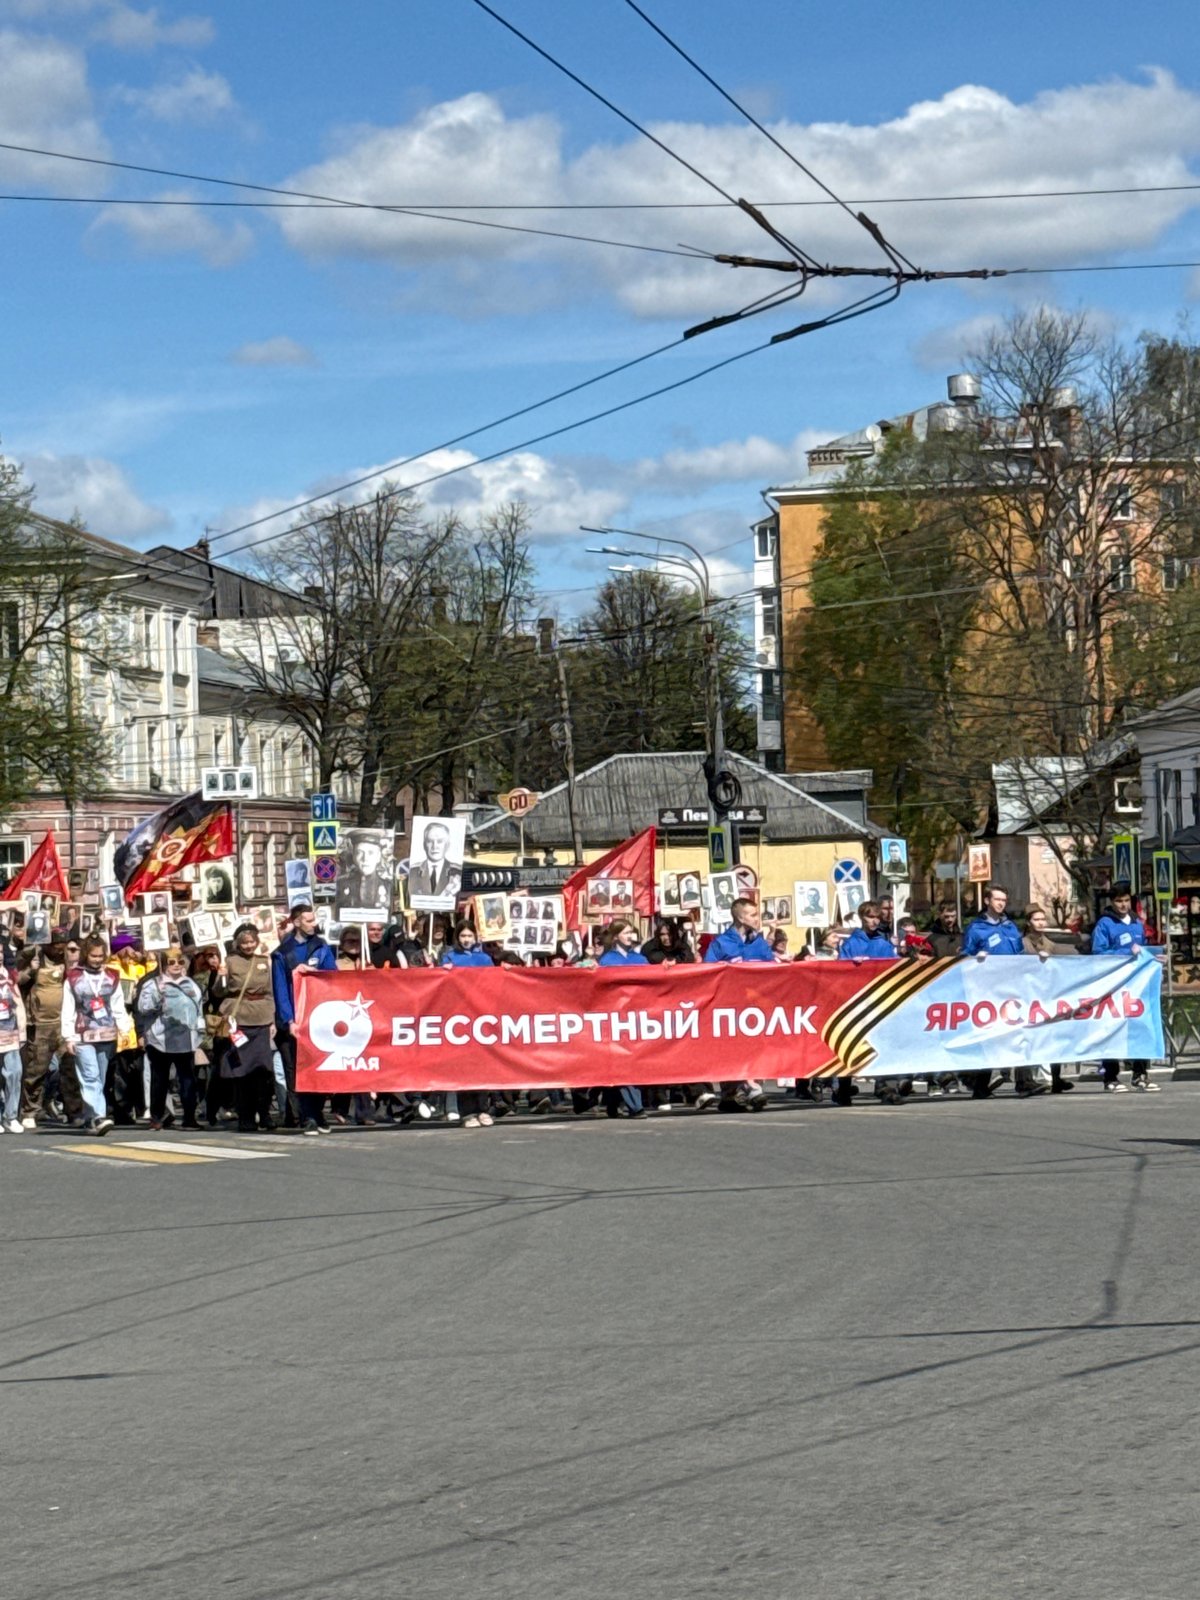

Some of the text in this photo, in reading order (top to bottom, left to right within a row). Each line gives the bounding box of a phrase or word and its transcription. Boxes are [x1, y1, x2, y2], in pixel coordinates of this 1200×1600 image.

[309, 999, 374, 1071] 9
[391, 1002, 818, 1046] БЕССМЕРТНЫЙ ПОЛК
[342, 1056, 380, 1072] МАЯ
